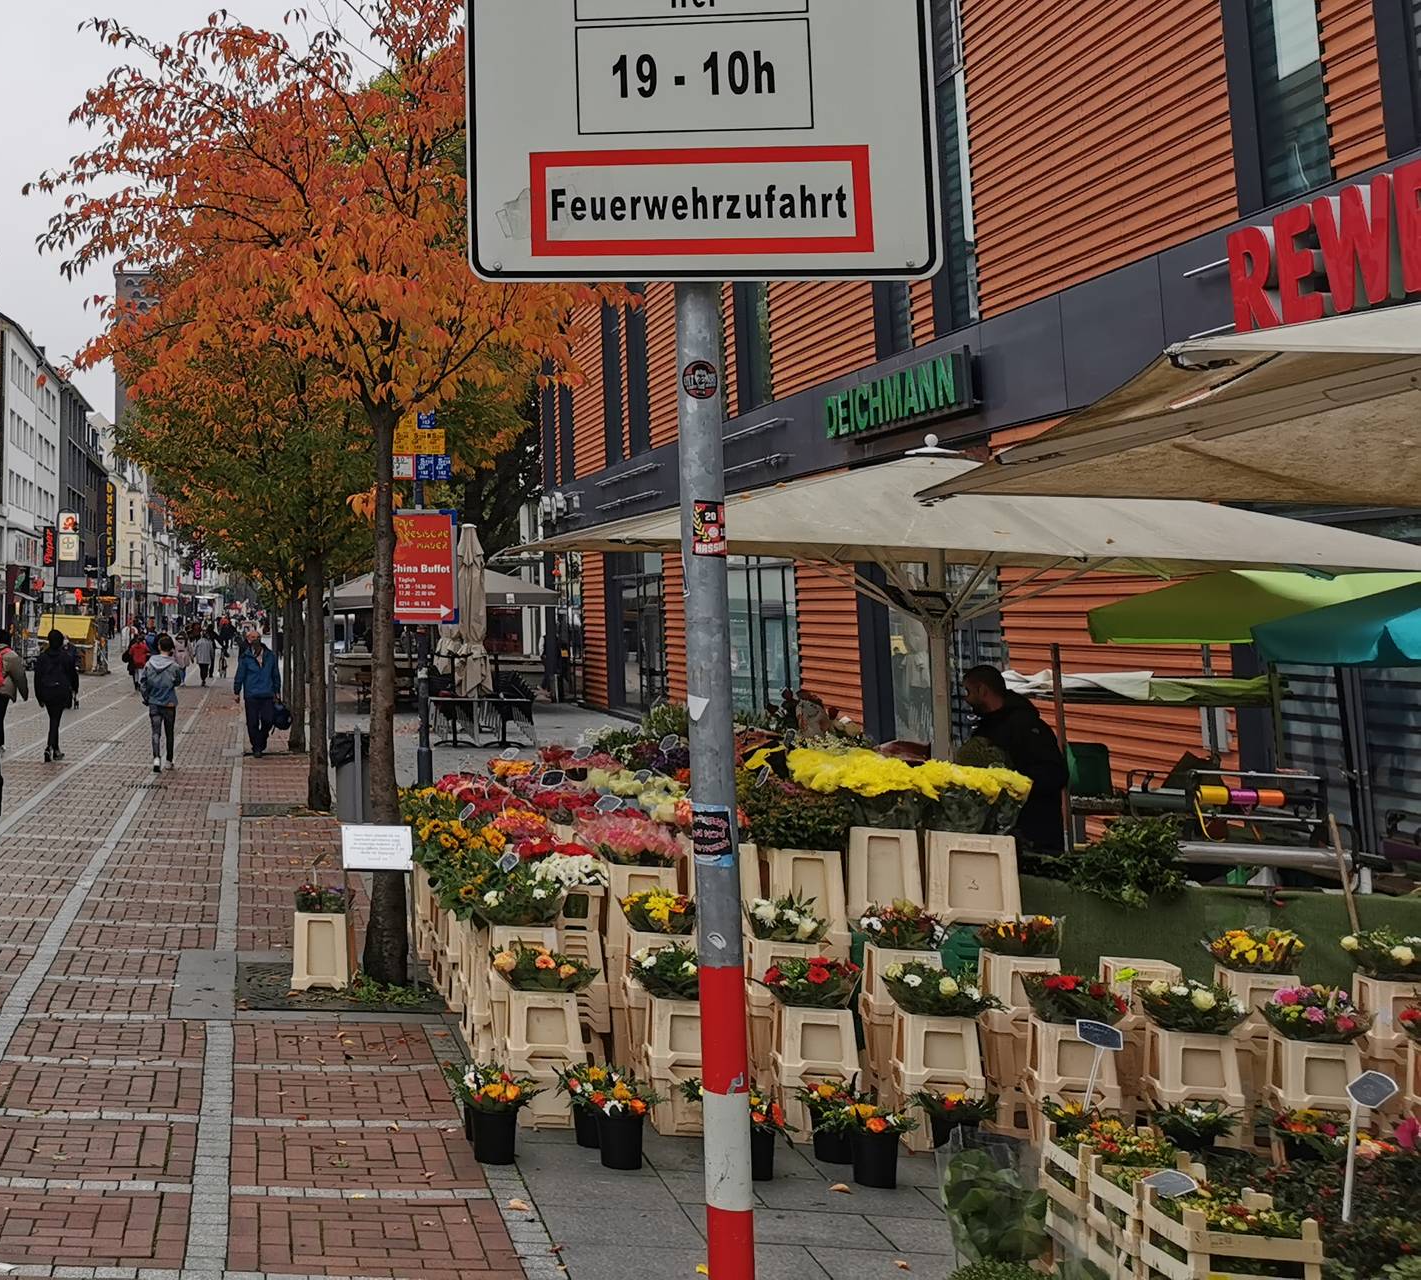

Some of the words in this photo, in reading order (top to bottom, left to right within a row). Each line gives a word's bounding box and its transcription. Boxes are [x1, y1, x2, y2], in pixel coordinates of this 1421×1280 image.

[612, 54, 657, 98] 19
[674, 76, 685, 86] -
[703, 50, 776, 95] 10h
[551, 184, 848, 221] Feuerwehrzufahrt
[825, 353, 956, 439] DEICHMANN
[704, 512, 717, 521] 20
[420, 564, 450, 573] Buffet
